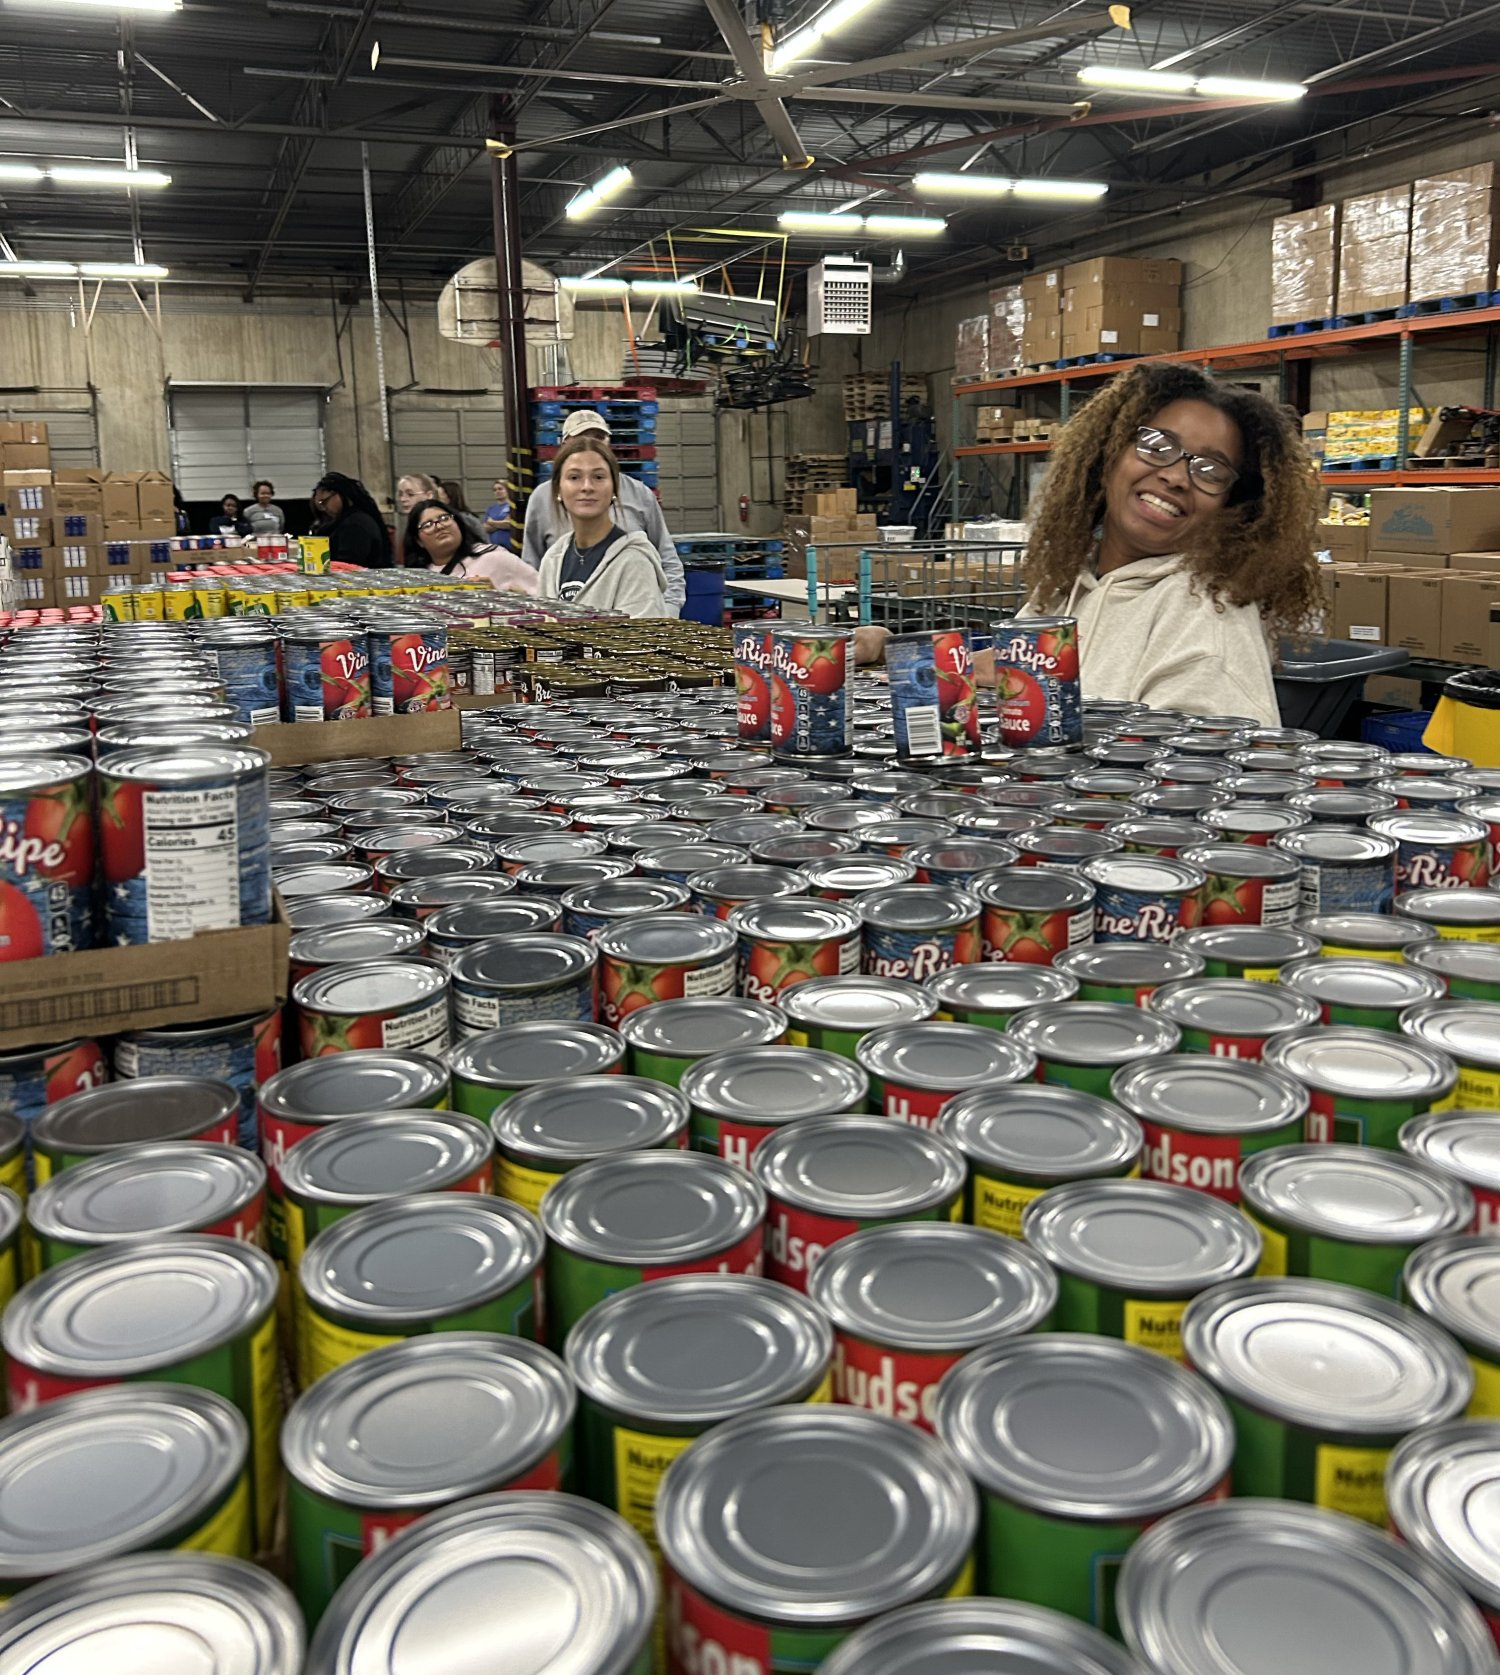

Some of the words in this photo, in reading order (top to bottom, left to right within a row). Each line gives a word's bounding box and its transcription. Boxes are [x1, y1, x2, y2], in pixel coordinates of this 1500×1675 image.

[405, 647, 446, 672] Vine
[1009, 639, 1058, 671] Ripe
[146, 794, 199, 804] Nutrition
[203, 791, 235, 801] Facts
[147, 837, 197, 847] Calories
[217, 827, 236, 841] 45
[51, 886, 66, 900] 45
[1304, 894, 1318, 904] 45
[471, 999, 497, 1009] Facts
[385, 1013, 428, 1031] Nutrition
